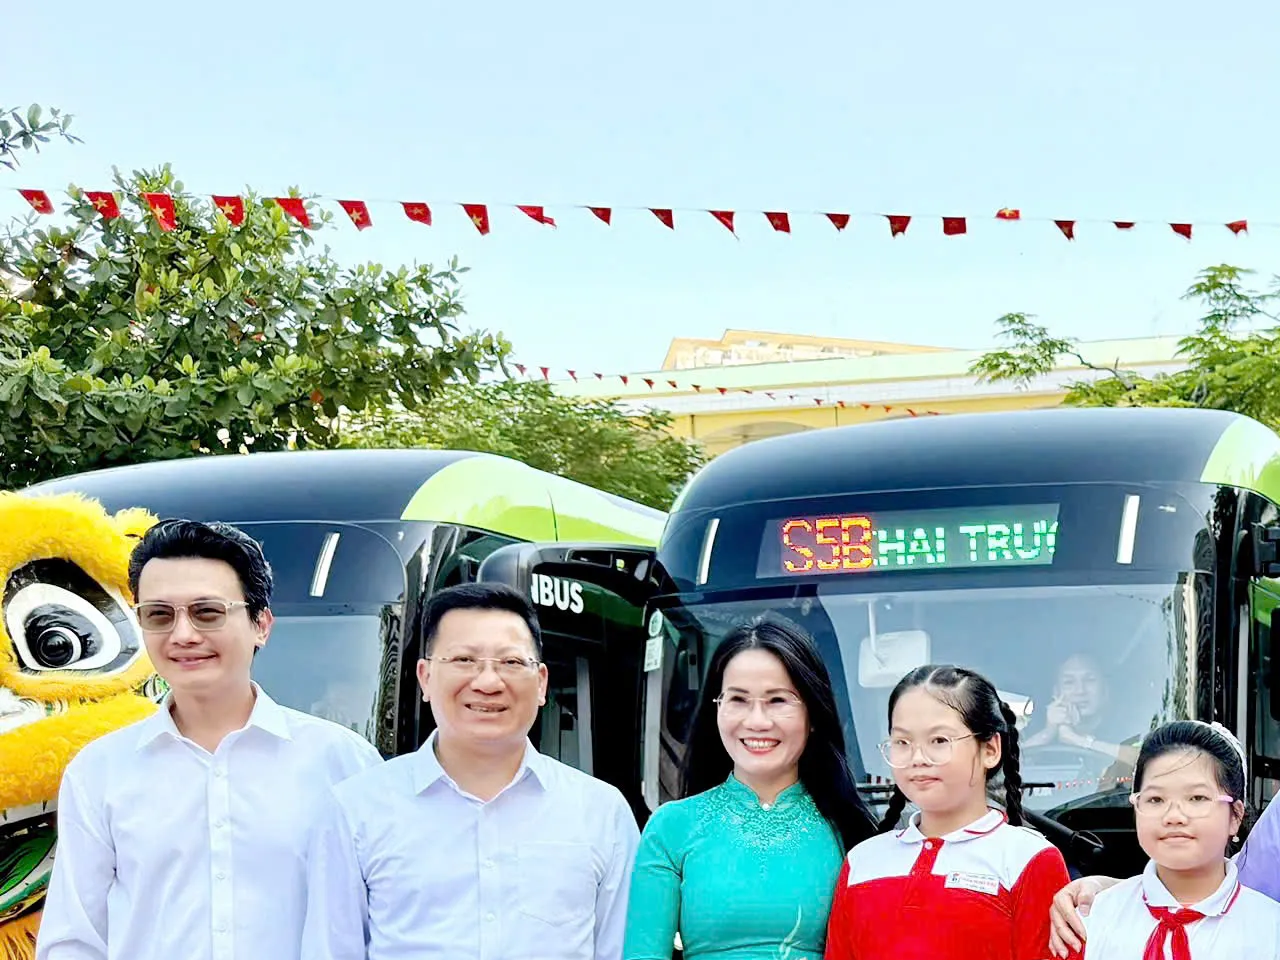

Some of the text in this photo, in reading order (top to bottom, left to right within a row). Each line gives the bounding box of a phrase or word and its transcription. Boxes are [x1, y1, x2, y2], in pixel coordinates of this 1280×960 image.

[783, 516, 872, 572] S5B
[871, 526, 946, 567] HAI
[530, 572, 585, 614] NBUS
